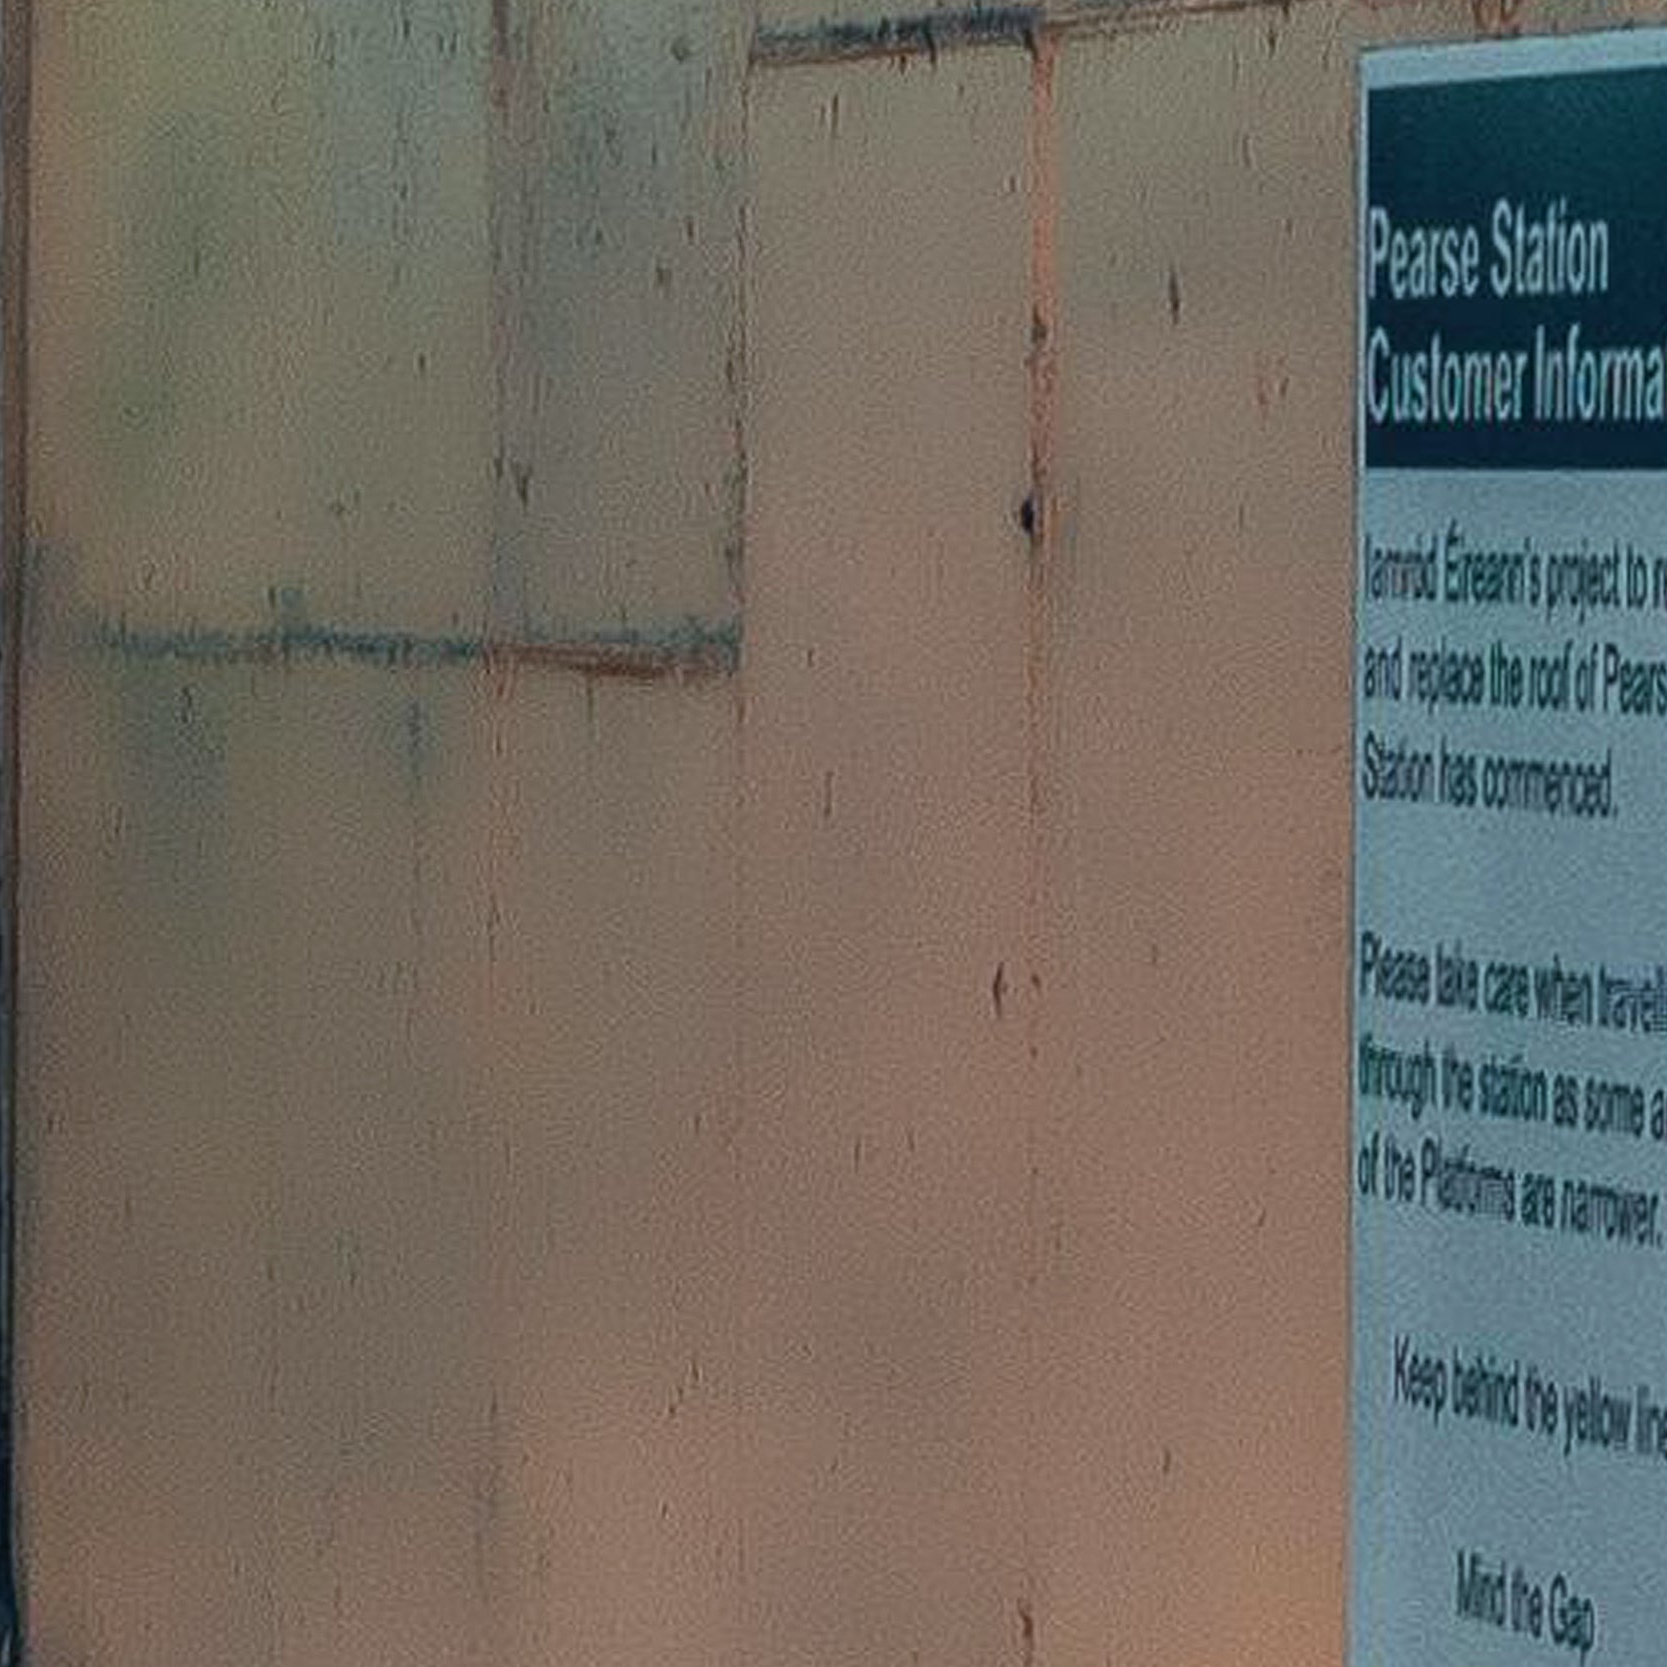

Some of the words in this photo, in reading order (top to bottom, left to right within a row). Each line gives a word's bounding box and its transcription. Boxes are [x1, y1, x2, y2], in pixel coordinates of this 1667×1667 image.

[1369, 206, 1479, 299] Pearse
[1491, 196, 1609, 297] Station
[1367, 325, 1527, 423] Customer
[1535, 322, 1665, 422] Informa
[1544, 537, 1620, 626] project
[1624, 543, 1648, 610] to
[1364, 636, 1402, 700] and
[1490, 640, 1522, 708] the
[1529, 639, 1573, 711] roof
[1575, 642, 1598, 712] of
[1362, 731, 1434, 802] Station
[1439, 737, 1478, 807] has
[1360, 930, 1430, 1004] Please
[1359, 1034, 1436, 1120] through
[1440, 1046, 1473, 1113] the
[1478, 1055, 1548, 1122] station
[1552, 1073, 1579, 1129] as
[1358, 1131, 1380, 1196] of
[1384, 1134, 1415, 1202] the
[1520, 1172, 1555, 1229] are
[1393, 1334, 1447, 1429] Keep
[1451, 1346, 1519, 1427] behind
[1525, 1364, 1558, 1434] the
[1563, 1375, 1631, 1457] yellow
[1457, 1550, 1506, 1627] Mind
[1511, 1567, 1542, 1638] the
